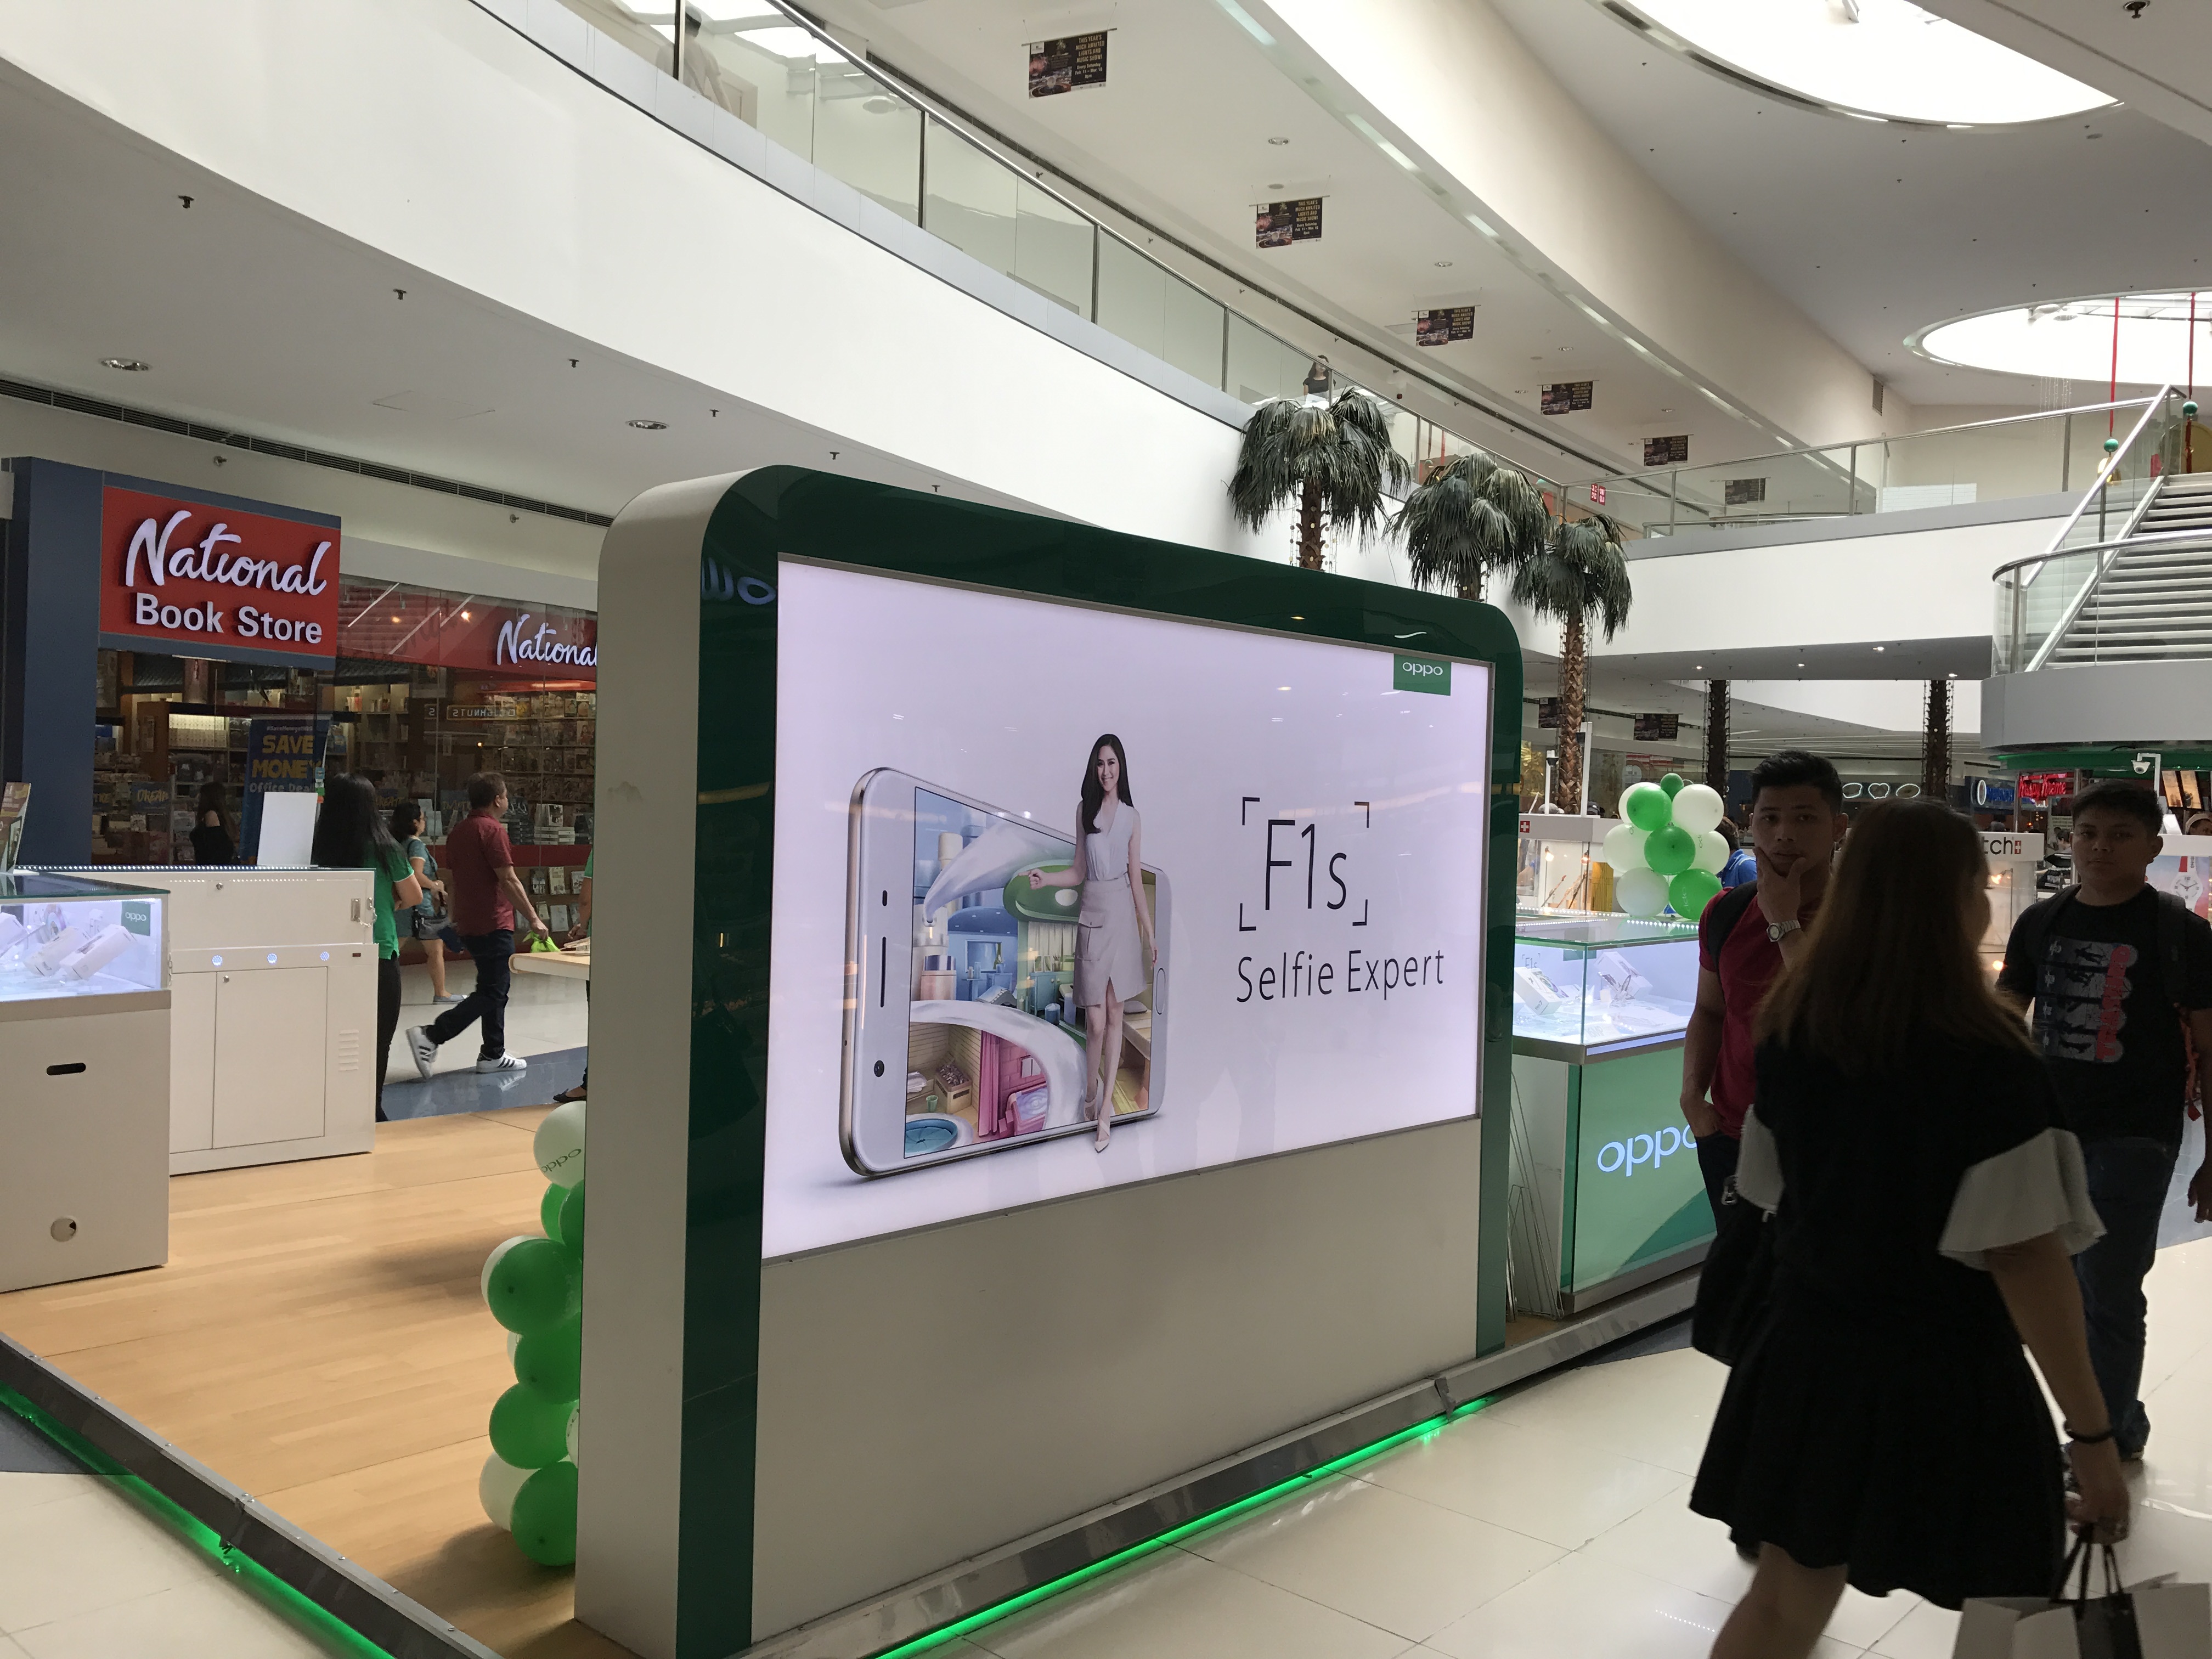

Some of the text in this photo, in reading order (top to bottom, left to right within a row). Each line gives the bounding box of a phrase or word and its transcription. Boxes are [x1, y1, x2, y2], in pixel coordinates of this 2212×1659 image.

[126, 510, 331, 595] National
[136, 592, 224, 633] Book
[238, 606, 322, 644] Store
[1402, 661, 1443, 678] oppo
[262, 734, 314, 754] SAVE
[1265, 819, 1347, 910] F1s
[1982, 836, 2013, 855] tch
[1237, 949, 1444, 1002] Selfie Expert
